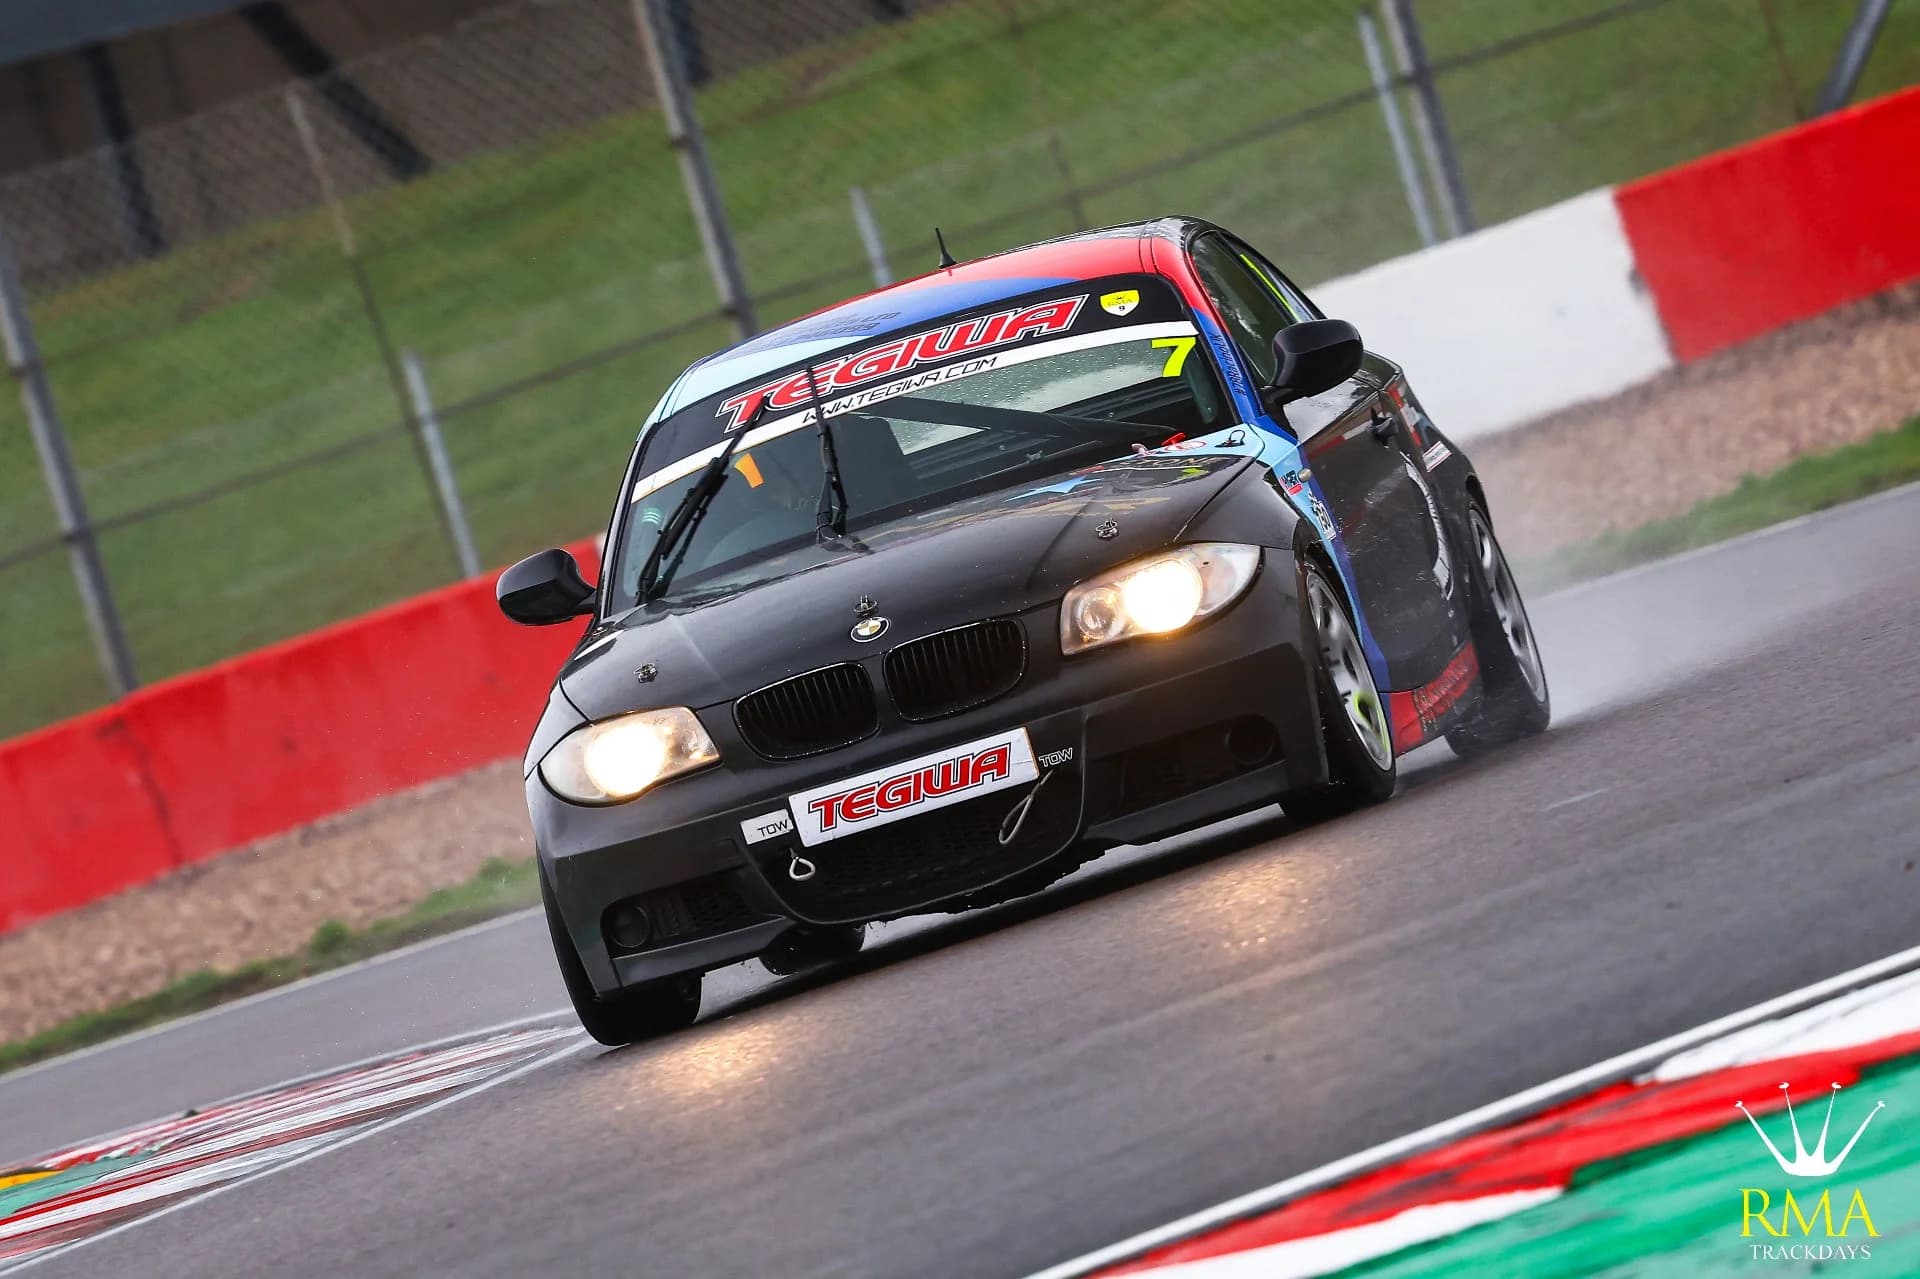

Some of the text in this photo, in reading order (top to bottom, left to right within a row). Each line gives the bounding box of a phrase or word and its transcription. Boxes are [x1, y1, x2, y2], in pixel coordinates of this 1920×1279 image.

[716, 295, 1089, 433] TEGIWA
[1151, 336, 1196, 378] 7
[1039, 747, 1073, 768] TOW
[808, 742, 1011, 833] TEGIWA
[757, 818, 788, 838] TOW
